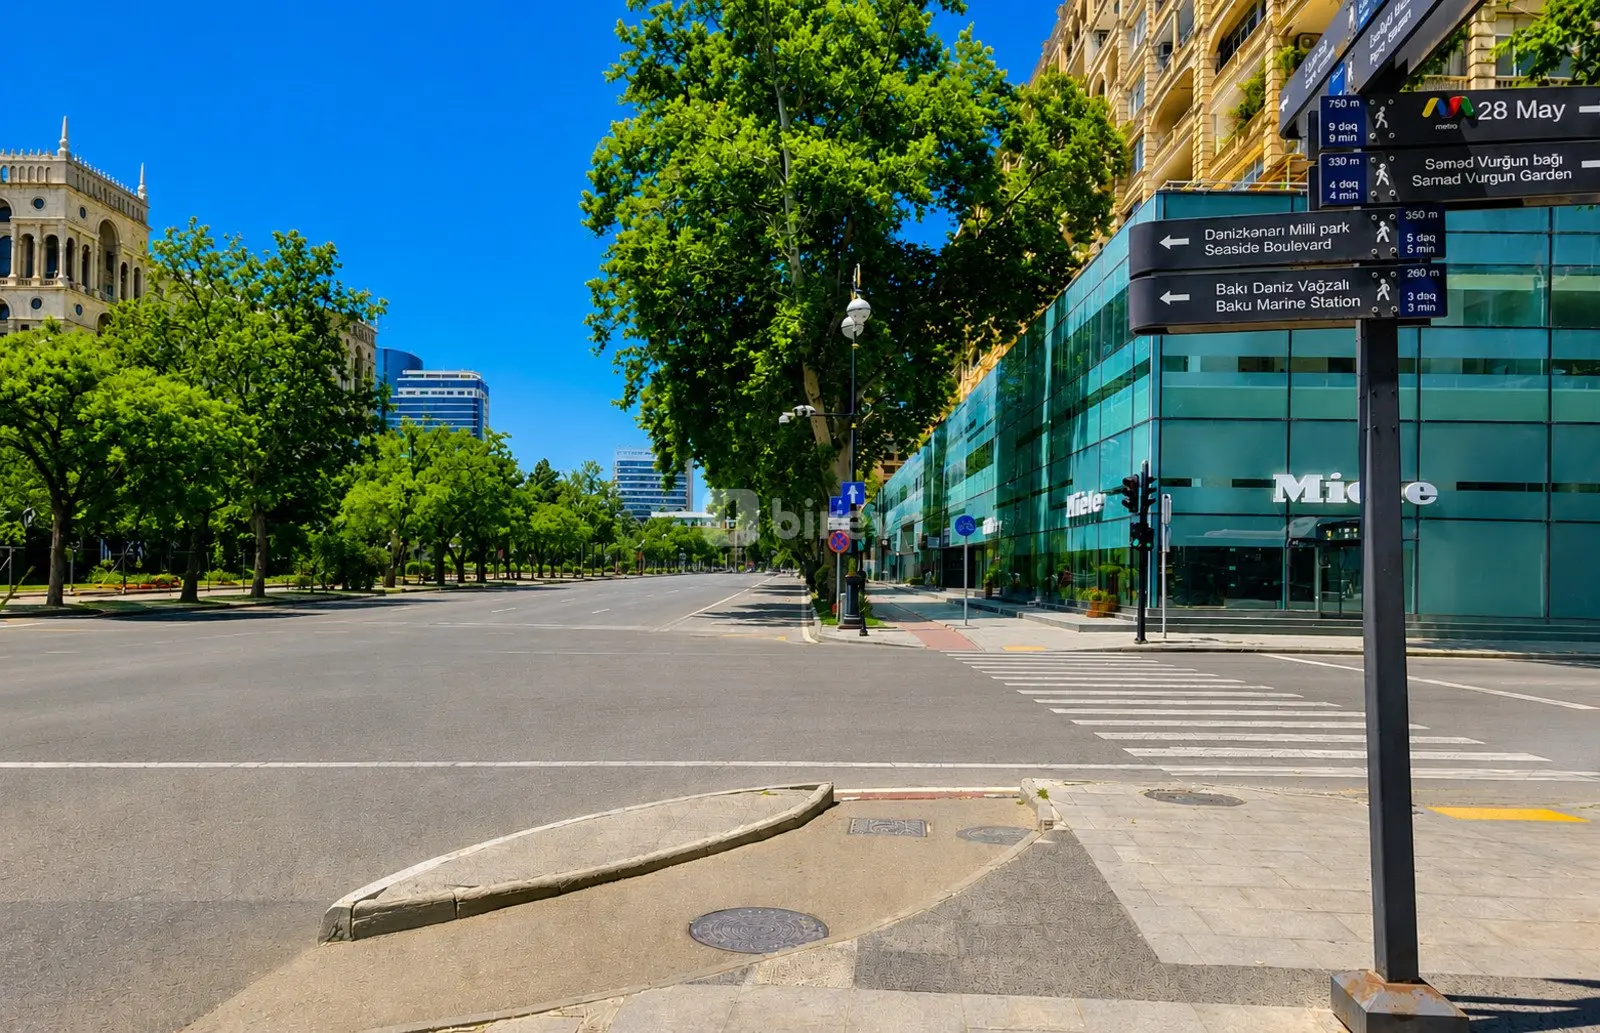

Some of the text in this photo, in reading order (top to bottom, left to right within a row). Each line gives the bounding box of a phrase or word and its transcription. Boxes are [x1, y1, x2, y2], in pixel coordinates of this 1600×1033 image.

[1478, 100, 1566, 122] 28 May
[1328, 122, 1358, 132] 9 dəq
[1329, 132, 1357, 143] 9 min
[1328, 157, 1347, 166] 330
[1425, 153, 1563, 170] Səməd Vurğun bağı
[1412, 169, 1572, 187] Samad Vurgun Garden
[1329, 181, 1336, 189] 4
[1329, 190, 1358, 200] 4 min
[1405, 210, 1425, 220] 350
[1289, 223, 1316, 236] Milli
[1319, 222, 1350, 237] park
[1406, 233, 1413, 242] 5
[1204, 239, 1332, 256] Seaside Boulevard
[1406, 243, 1435, 253] 5 min
[1216, 279, 1350, 295] Bakı Dəniz Vağzalı
[1407, 292, 1414, 301] 3
[1216, 295, 1361, 313] Baku Marine Station
[1407, 302, 1436, 312] 3 min
[1272, 472, 1438, 505] Mie
